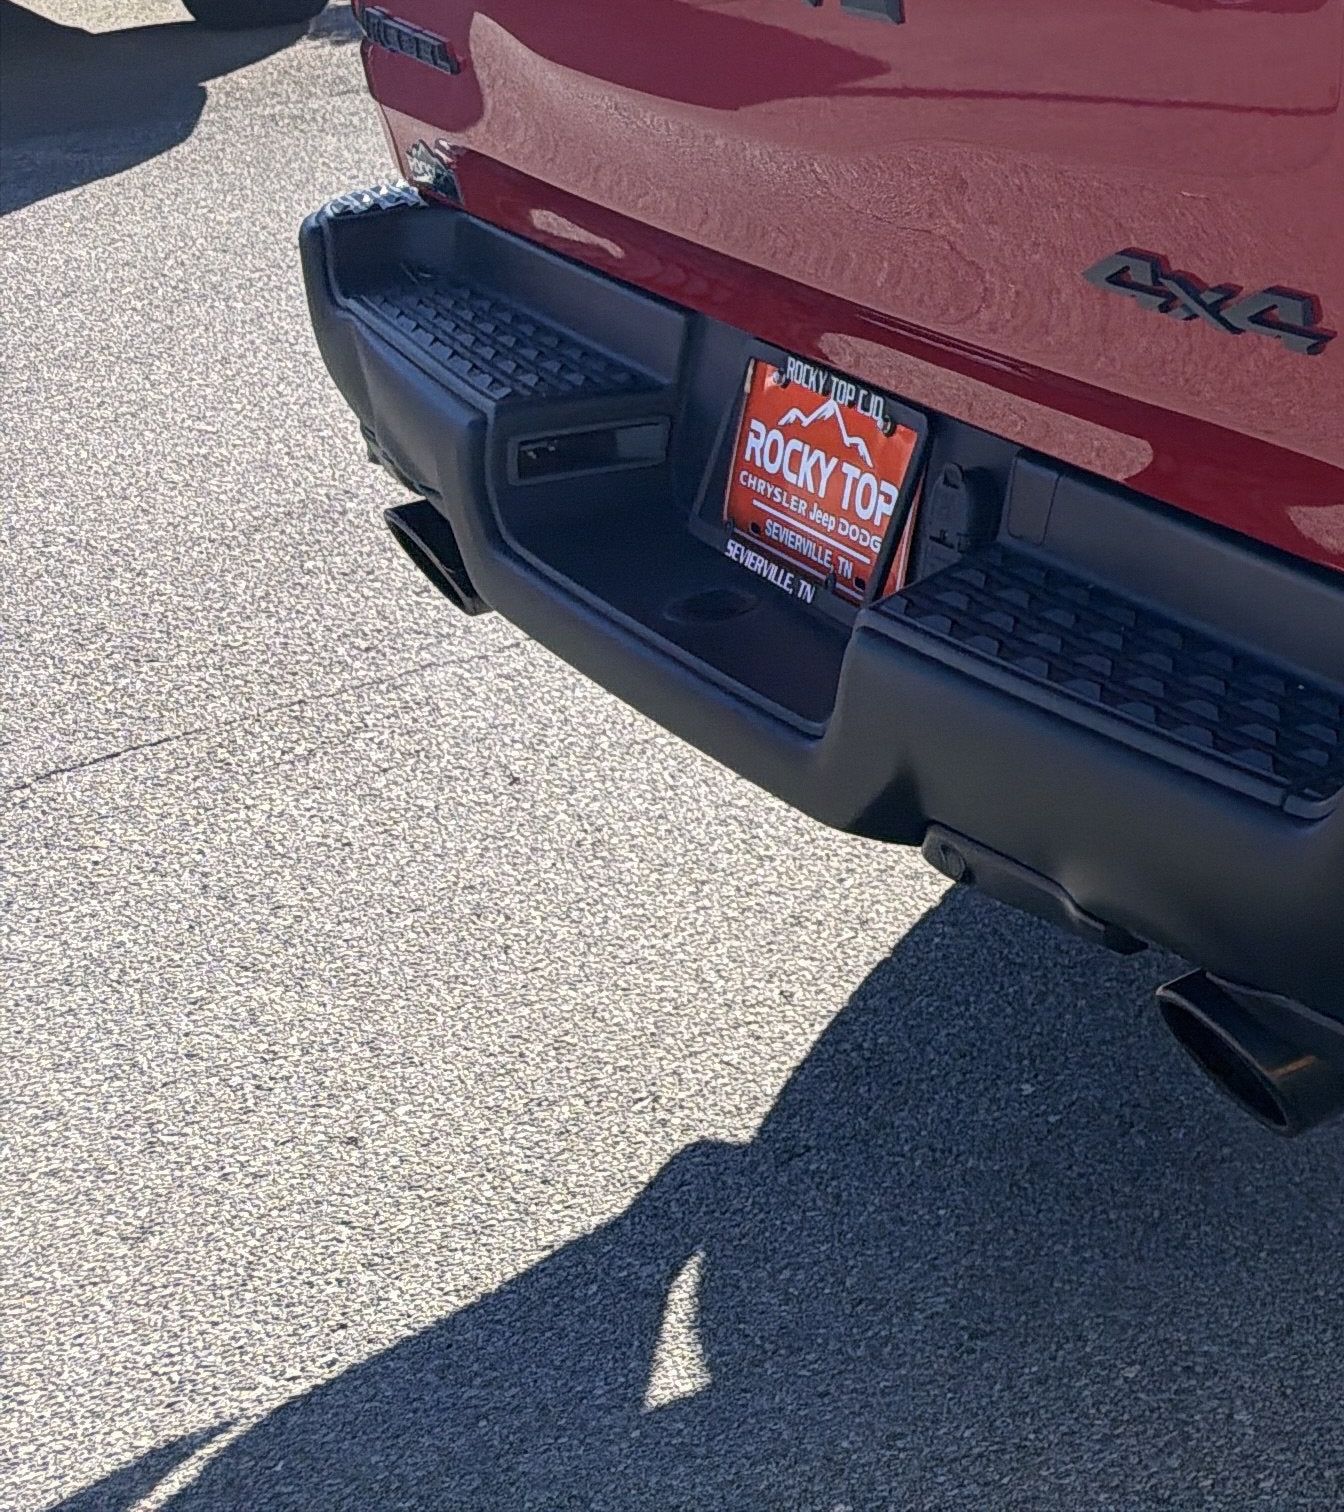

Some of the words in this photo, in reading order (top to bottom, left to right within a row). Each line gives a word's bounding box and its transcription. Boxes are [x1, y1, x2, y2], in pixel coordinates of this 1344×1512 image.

[786, 356, 828, 395] ROCKY
[831, 375, 856, 406] TOP
[744, 418, 838, 498] ROCKY
[841, 462, 899, 526] TOP
[739, 470, 807, 516] CHRYSLER
[809, 502, 836, 532] Jeep
[838, 517, 883, 555] DODG
[725, 538, 794, 594] SEVIERVILLE,
[799, 584, 817, 605] TN
[764, 518, 833, 572] SEVIERVILLE,
[837, 555, 854, 579] TN
